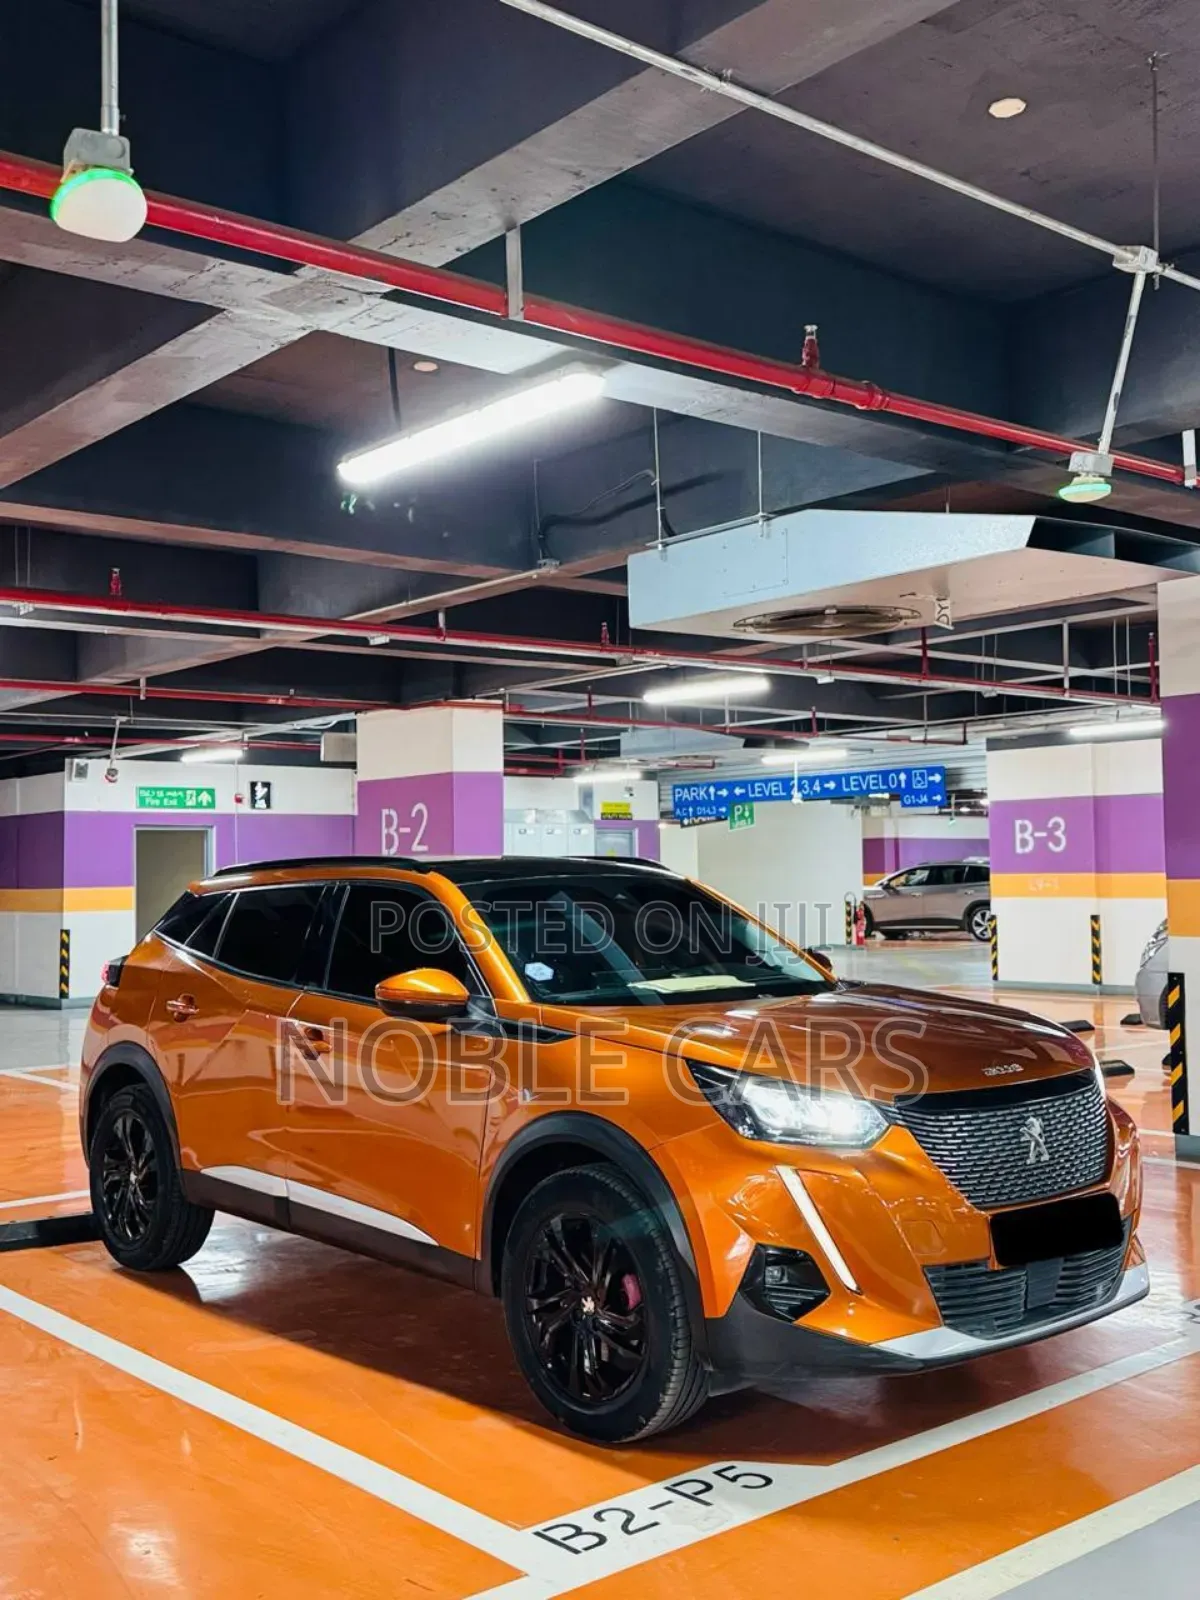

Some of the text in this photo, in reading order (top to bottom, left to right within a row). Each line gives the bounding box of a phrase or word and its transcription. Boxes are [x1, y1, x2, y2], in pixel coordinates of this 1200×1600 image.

[675, 773, 897, 801] PARK LEVEL 23,4 LEVEL 0
[381, 802, 429, 856] B-2
[734, 805, 743, 820] P
[1015, 816, 1067, 854] B-3
[532, 1465, 774, 1555] B2-P5
